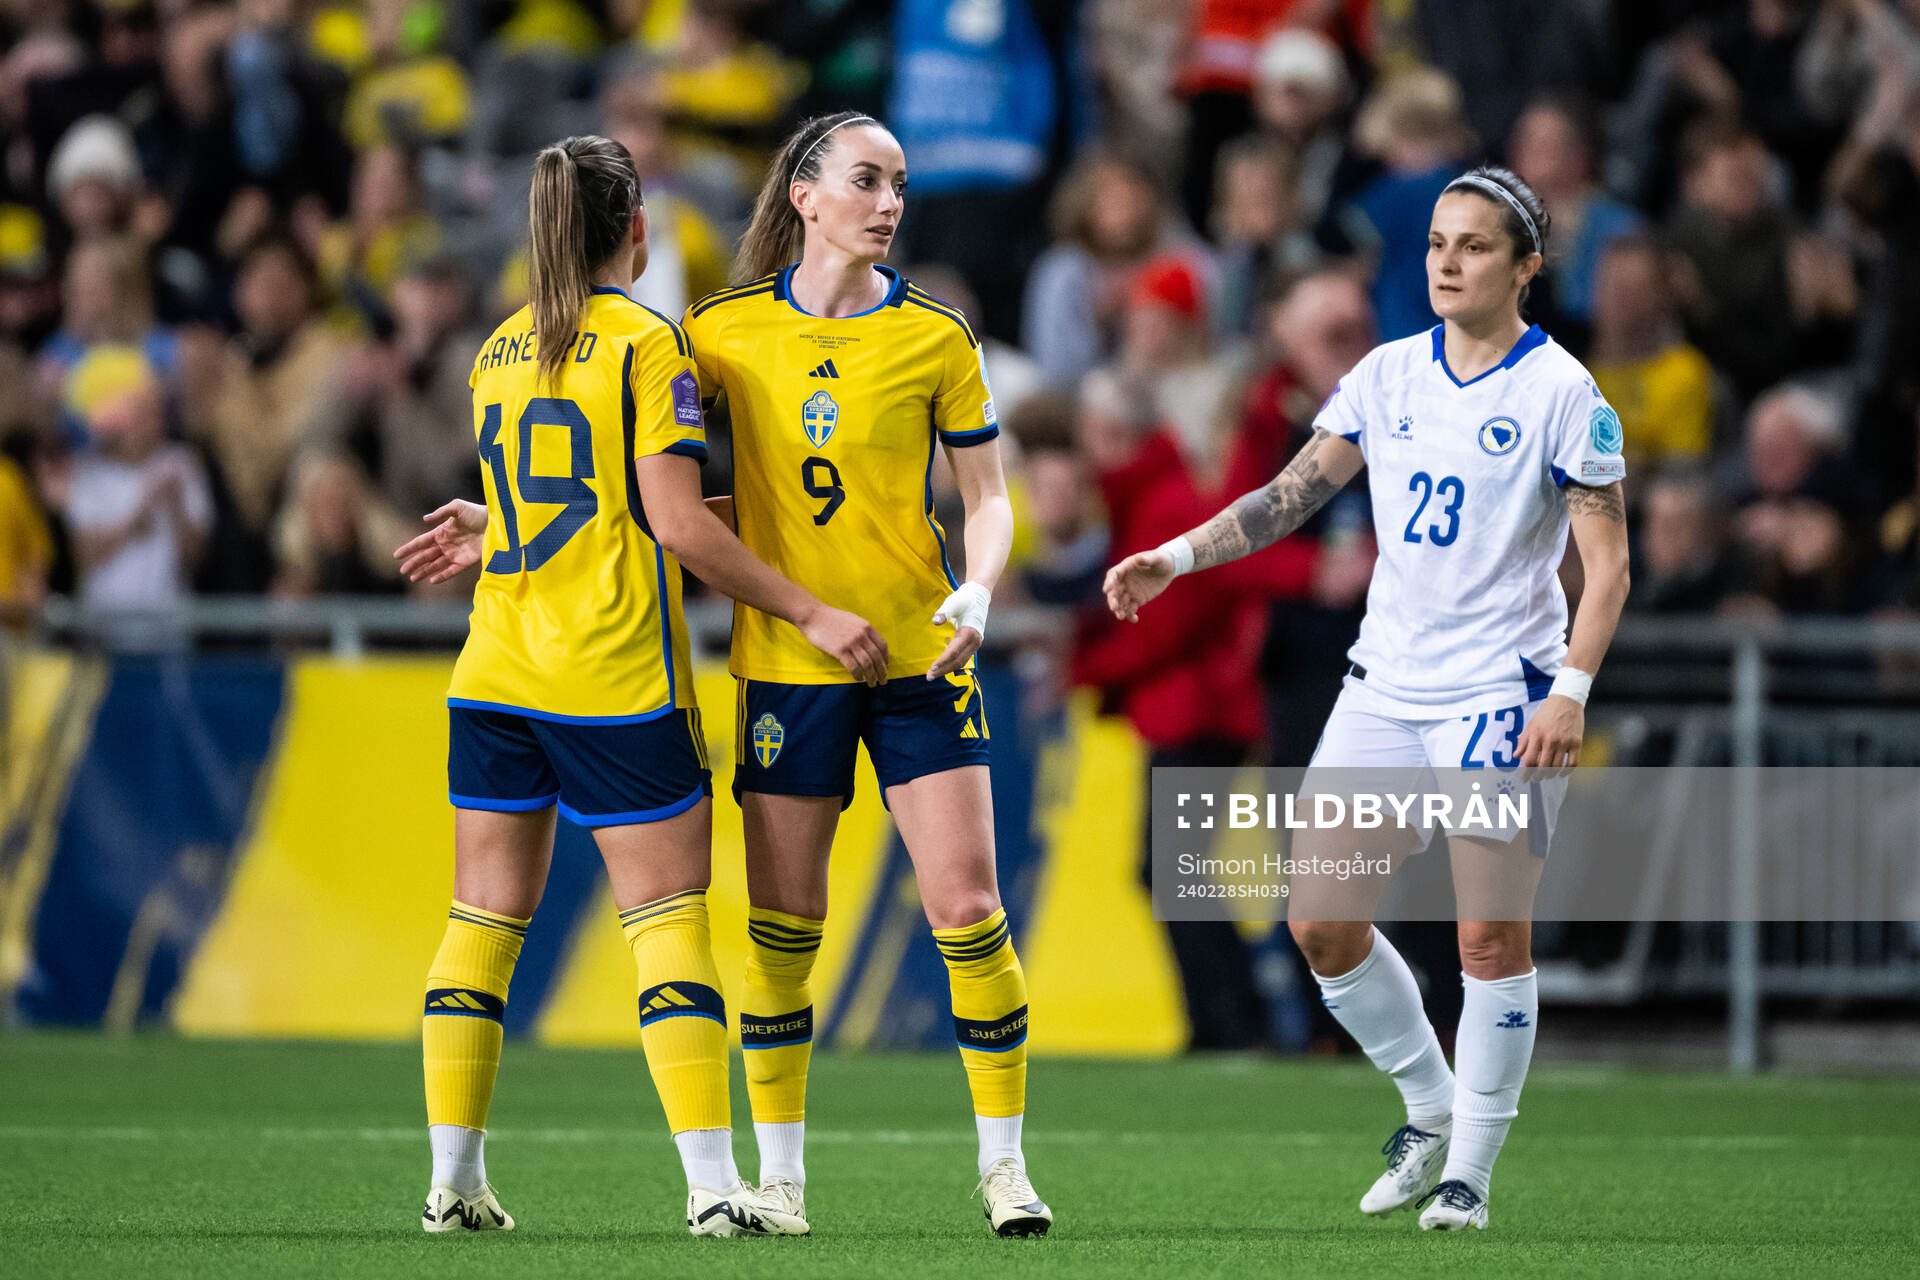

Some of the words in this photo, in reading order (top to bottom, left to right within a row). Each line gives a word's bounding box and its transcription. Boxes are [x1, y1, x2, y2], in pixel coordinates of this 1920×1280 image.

[480, 331, 598, 374] KANEYD
[479, 397, 599, 575] 19
[801, 456, 846, 526] 9
[1403, 471, 1465, 547] 23
[1460, 704, 1524, 773] 23
[741, 1017, 808, 1035] SVERIGE
[969, 1014, 1030, 1040] SVERIGE
